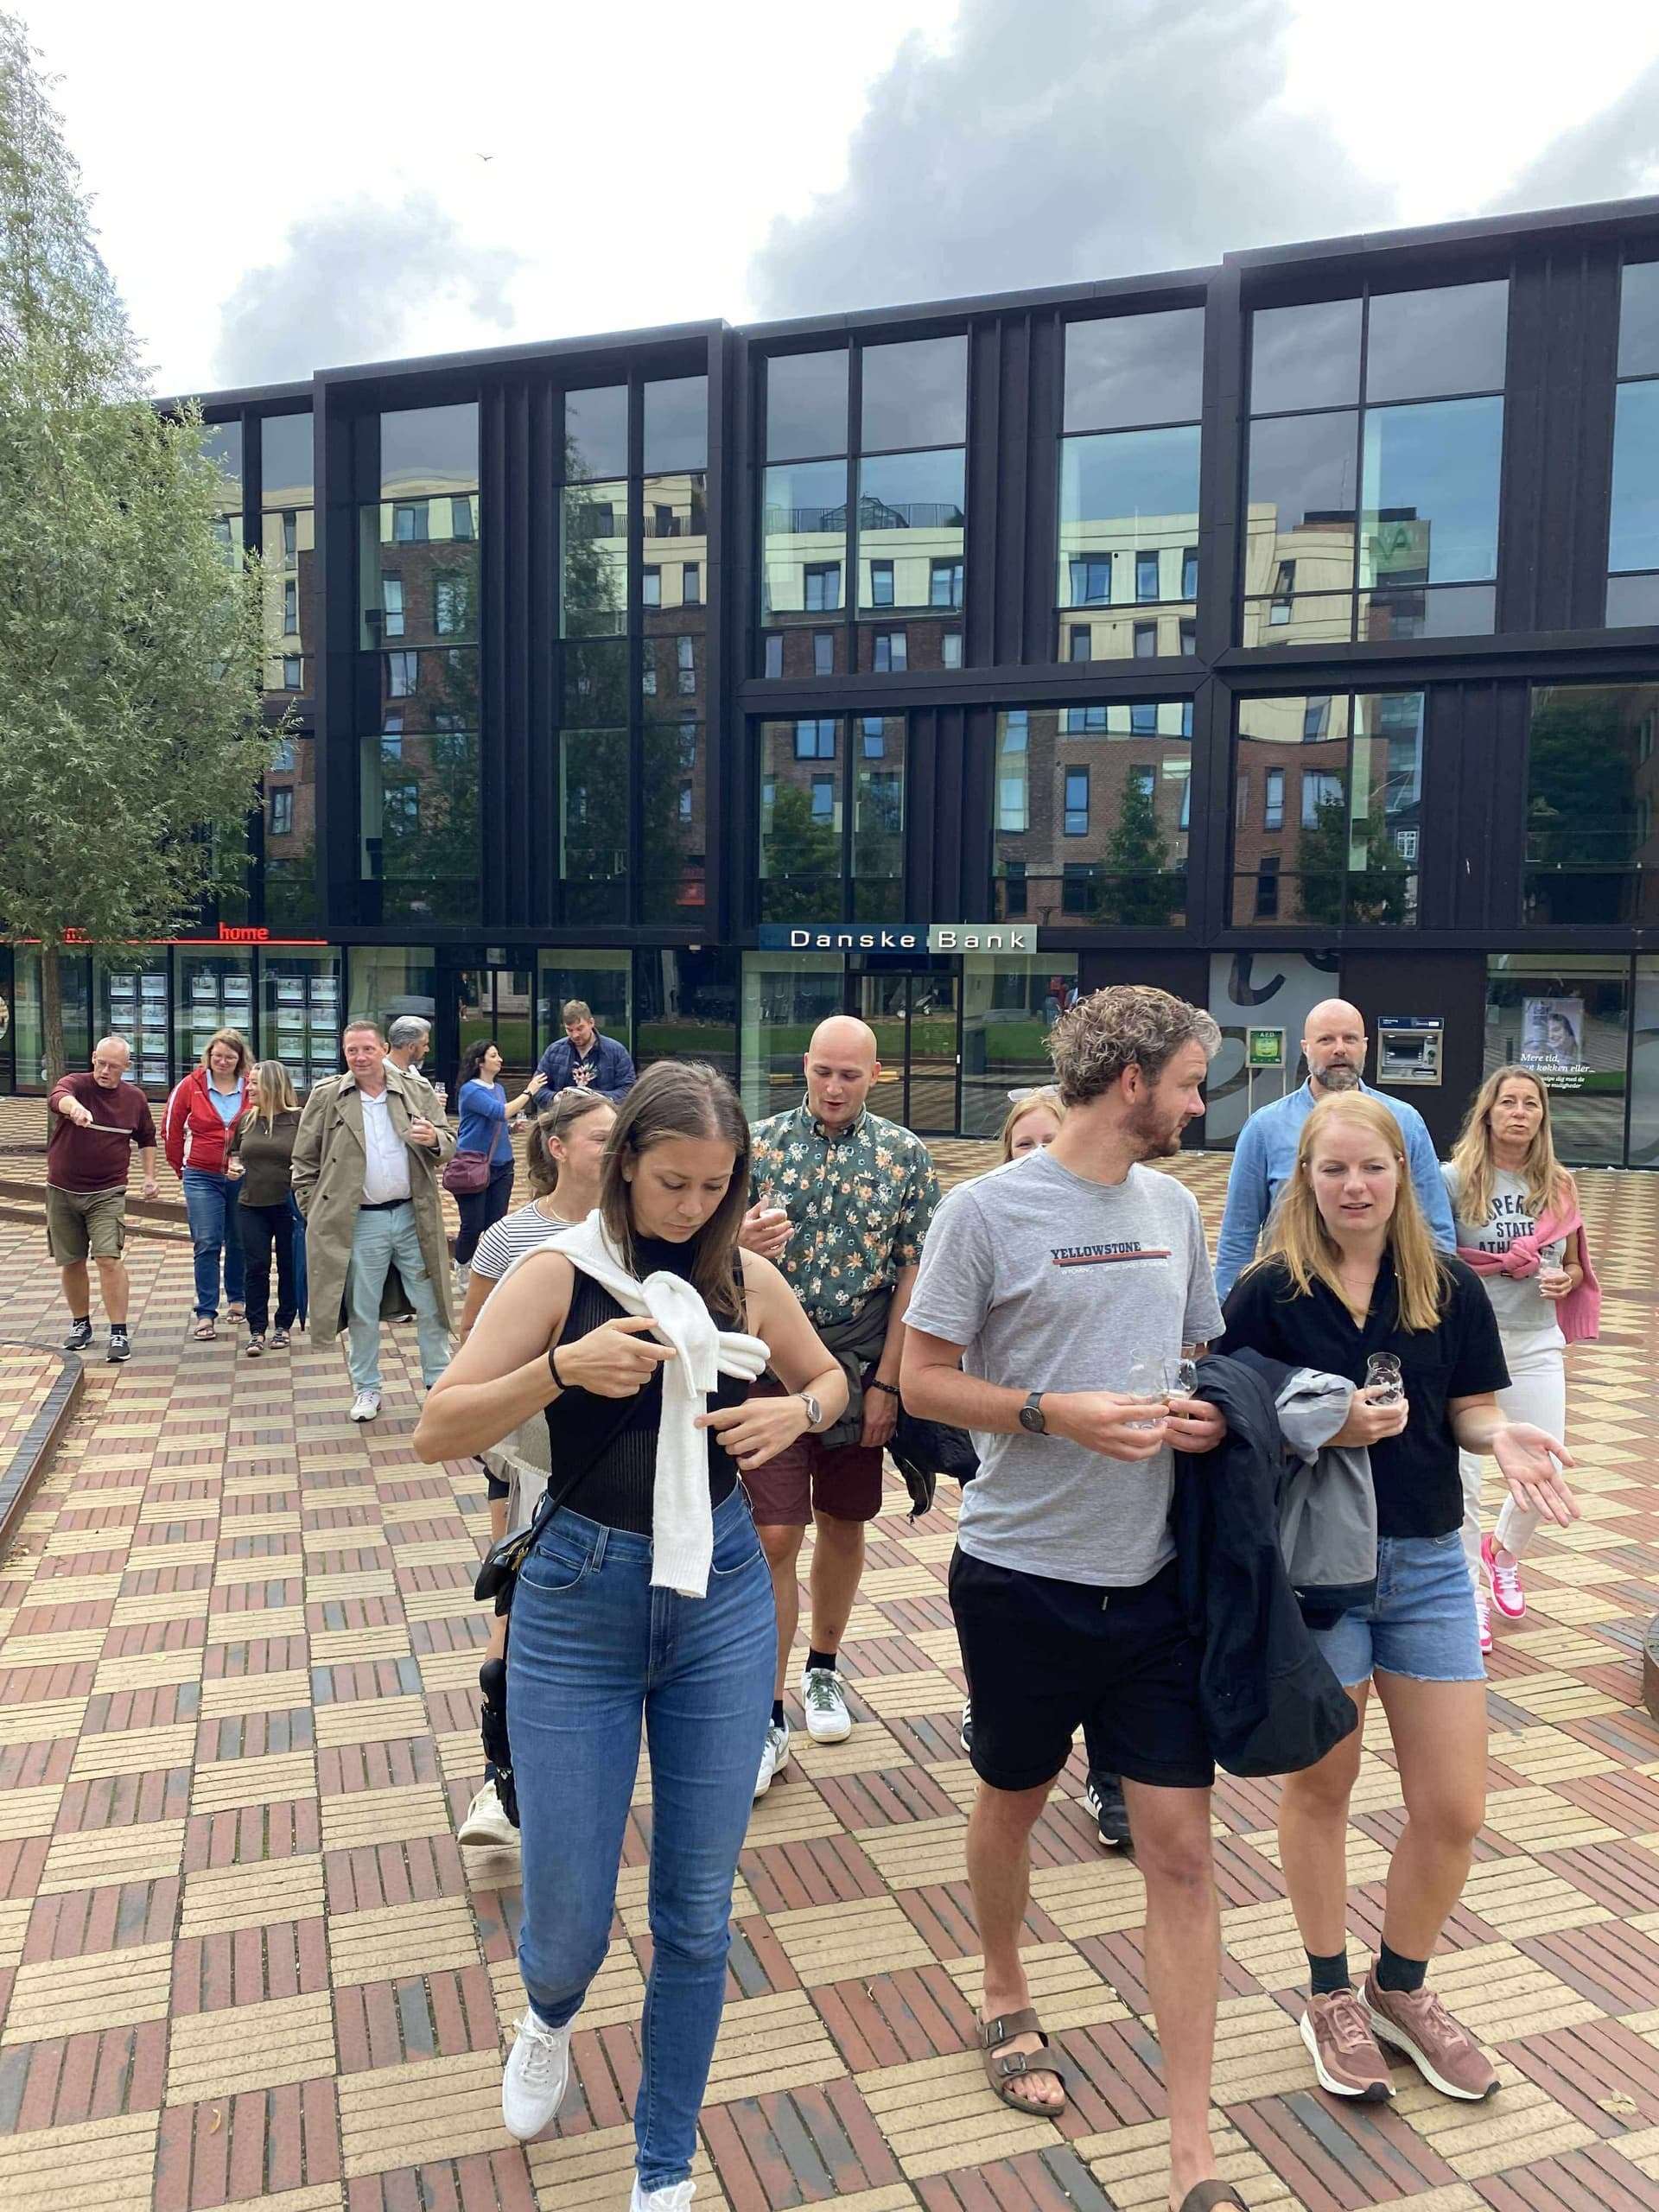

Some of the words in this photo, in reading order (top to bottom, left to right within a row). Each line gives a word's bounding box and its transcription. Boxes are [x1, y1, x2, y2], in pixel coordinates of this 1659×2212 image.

[219, 922, 270, 941] home
[790, 930, 916, 948] Danske
[938, 931, 1026, 949] Bank
[1521, 1053, 1543, 1062] Mere
[1496, 1222, 1535, 1237] STATE
[1051, 1242, 1141, 1260] YELLOWSTONE
